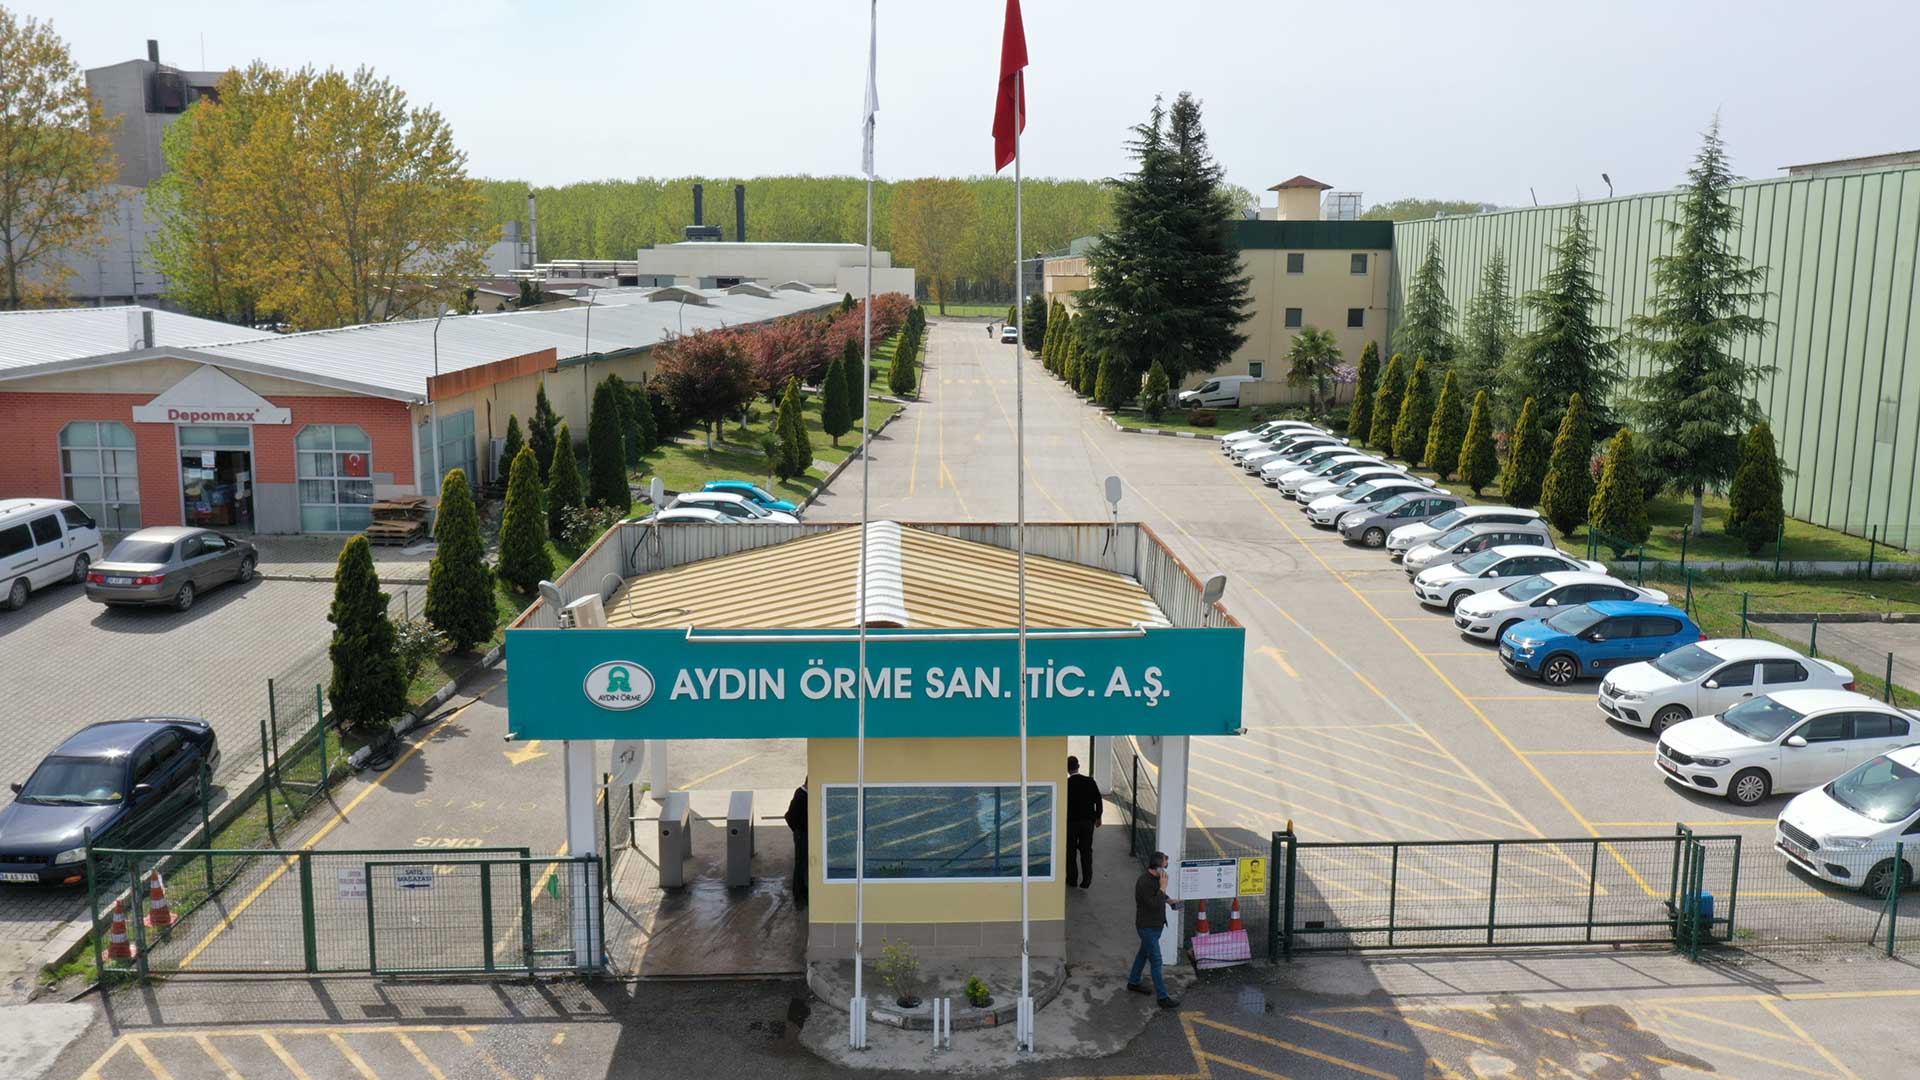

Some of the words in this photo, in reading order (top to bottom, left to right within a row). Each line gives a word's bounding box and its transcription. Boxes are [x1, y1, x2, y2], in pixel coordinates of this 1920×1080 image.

[168, 409, 255, 423] Depomaxx
[670, 668, 785, 699] AYDIN
[800, 659, 911, 699] ÖRME
[925, 667, 1011, 698] SAN.
[1026, 659, 1095, 697] TİC.
[1104, 666, 1170, 706] A.Ş.
